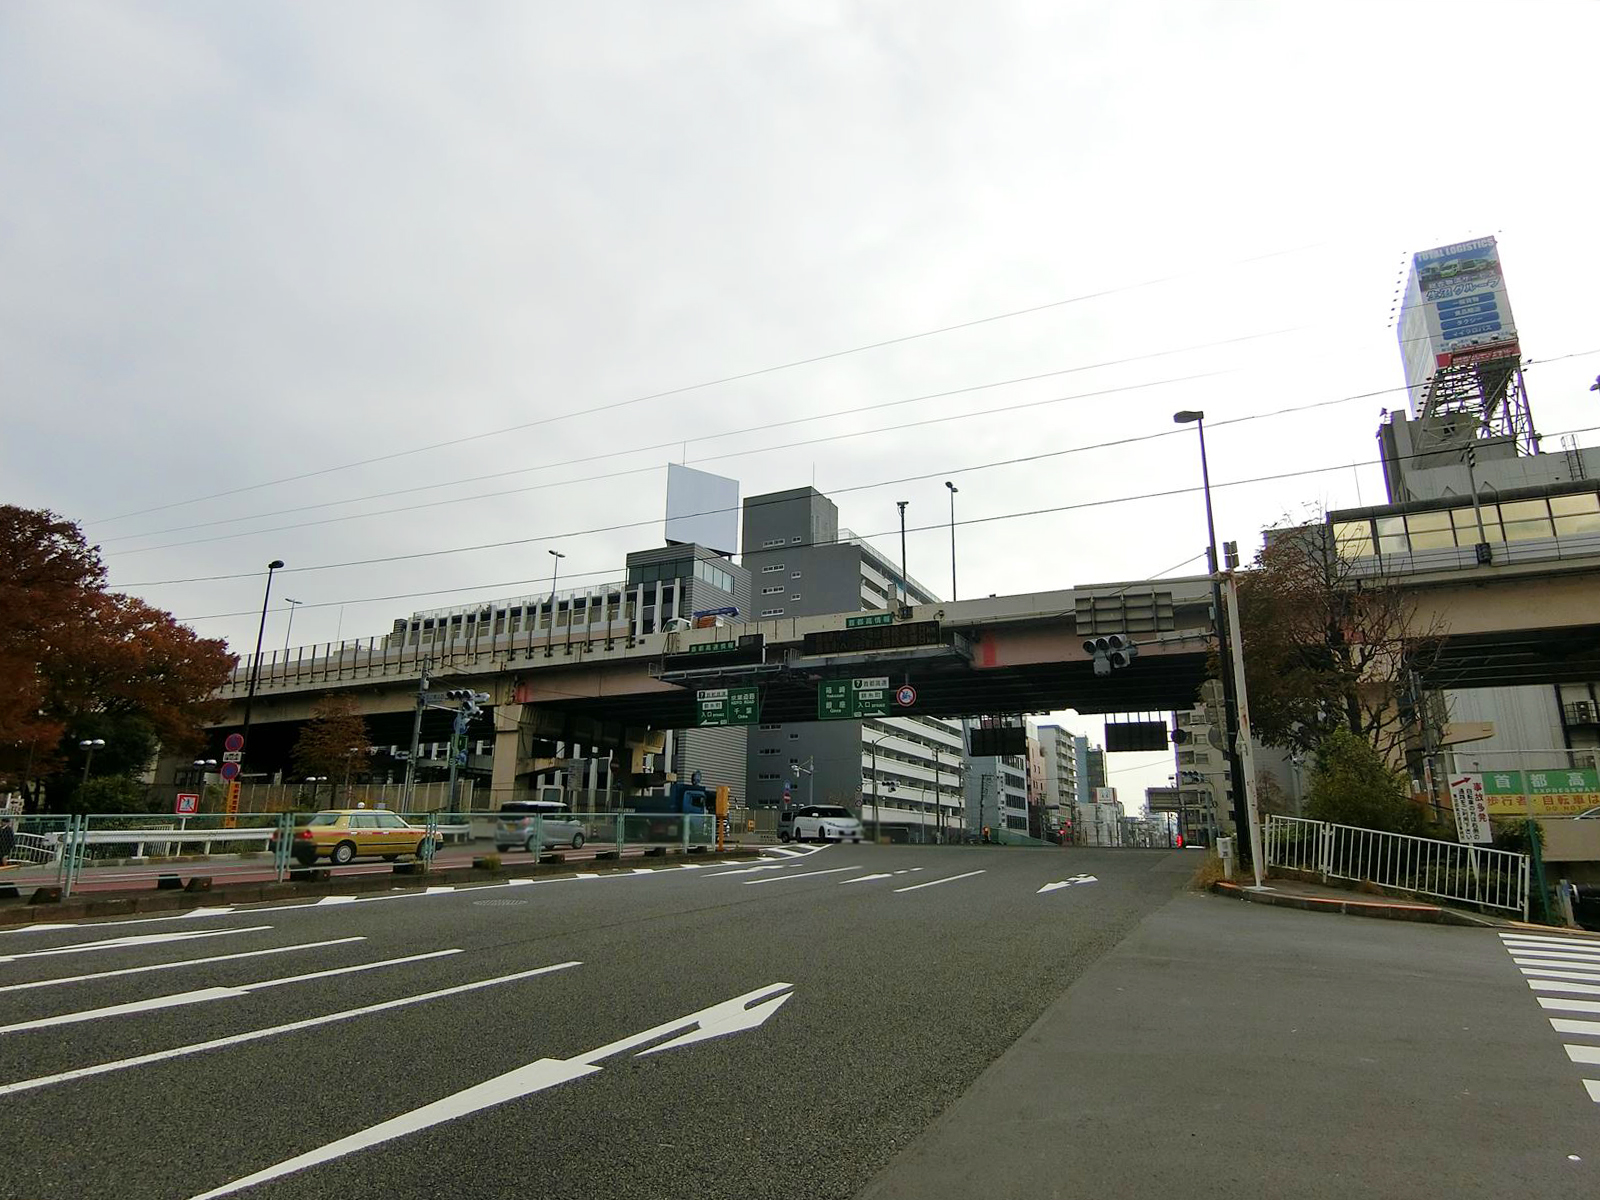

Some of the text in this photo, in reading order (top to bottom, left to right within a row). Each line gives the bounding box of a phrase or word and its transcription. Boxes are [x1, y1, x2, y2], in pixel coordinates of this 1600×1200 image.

[1417, 238, 1495, 262] TOTAL LOGISTICS
[1456, 317, 1483, 326] タクシー
[1494, 772, 1585, 788] 首都高
[1473, 782, 1487, 822] 事故多発
